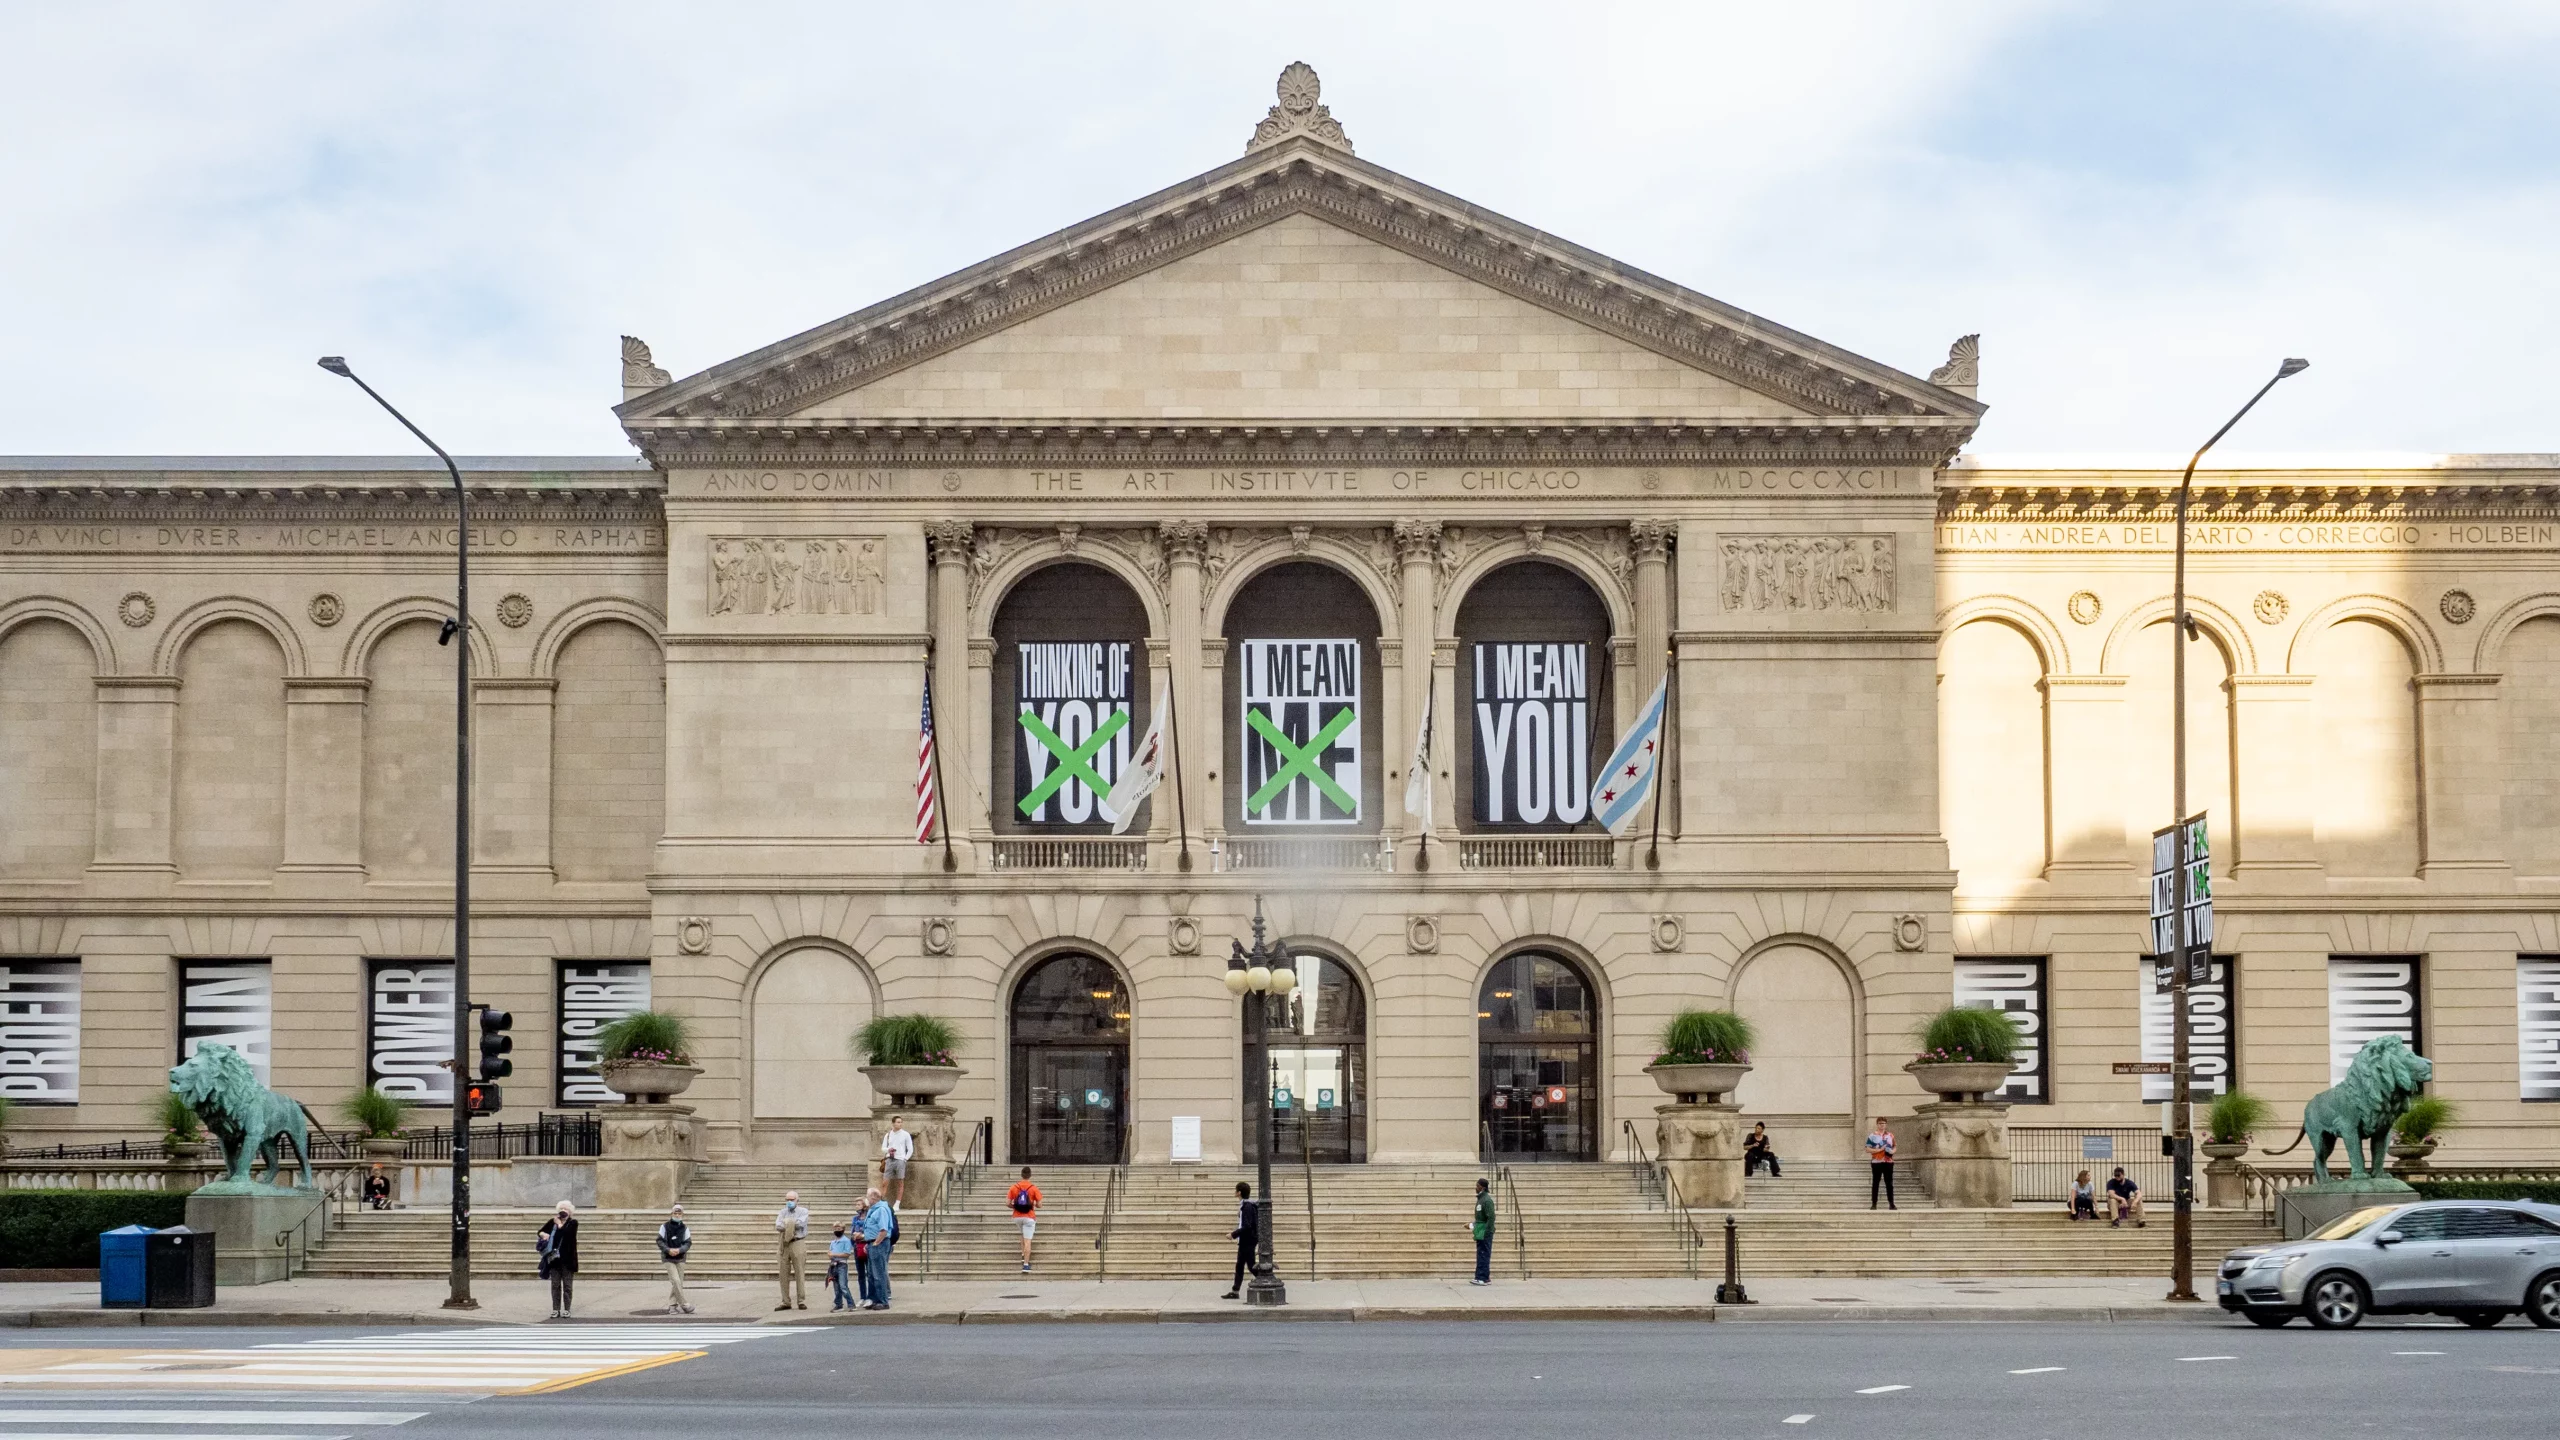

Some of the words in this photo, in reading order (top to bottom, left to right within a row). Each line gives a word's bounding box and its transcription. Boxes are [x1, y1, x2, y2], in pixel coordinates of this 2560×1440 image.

[704, 472, 779, 491] ANNO
[793, 472, 894, 491] DOMINI
[1030, 472, 1084, 491] THE
[1123, 472, 1175, 491] ART
[1211, 472, 1358, 491] INSTITVTE
[1392, 471, 1428, 490] OF
[1461, 471, 1580, 490] CHICAGO
[11, 528, 42, 546] DA
[53, 528, 121, 546] VINCI
[157, 528, 241, 546] DVRER
[277, 528, 394, 547] MICHAEL
[1934, 526, 1997, 544] ITIAN
[2019, 526, 2111, 545] ANDREA
[2124, 526, 2168, 545] DEL
[2183, 526, 2253, 545] SARTO
[2278, 526, 2421, 545] CORREGGIO
[2449, 526, 2553, 544] HOLBEIN
[1019, 642, 1103, 699] THINKING
[1108, 642, 1130, 699] OF
[1245, 643, 1254, 697] I
[1266, 643, 1356, 697] MEAN
[1475, 644, 1485, 699] I
[1496, 643, 1586, 699] MEAN
[1019, 699, 1130, 824] YOU
[1246, 701, 1357, 820] ME
[1476, 699, 1588, 824] YOU
[2194, 903, 2213, 945] YOU
[372, 968, 456, 1102] POWER
